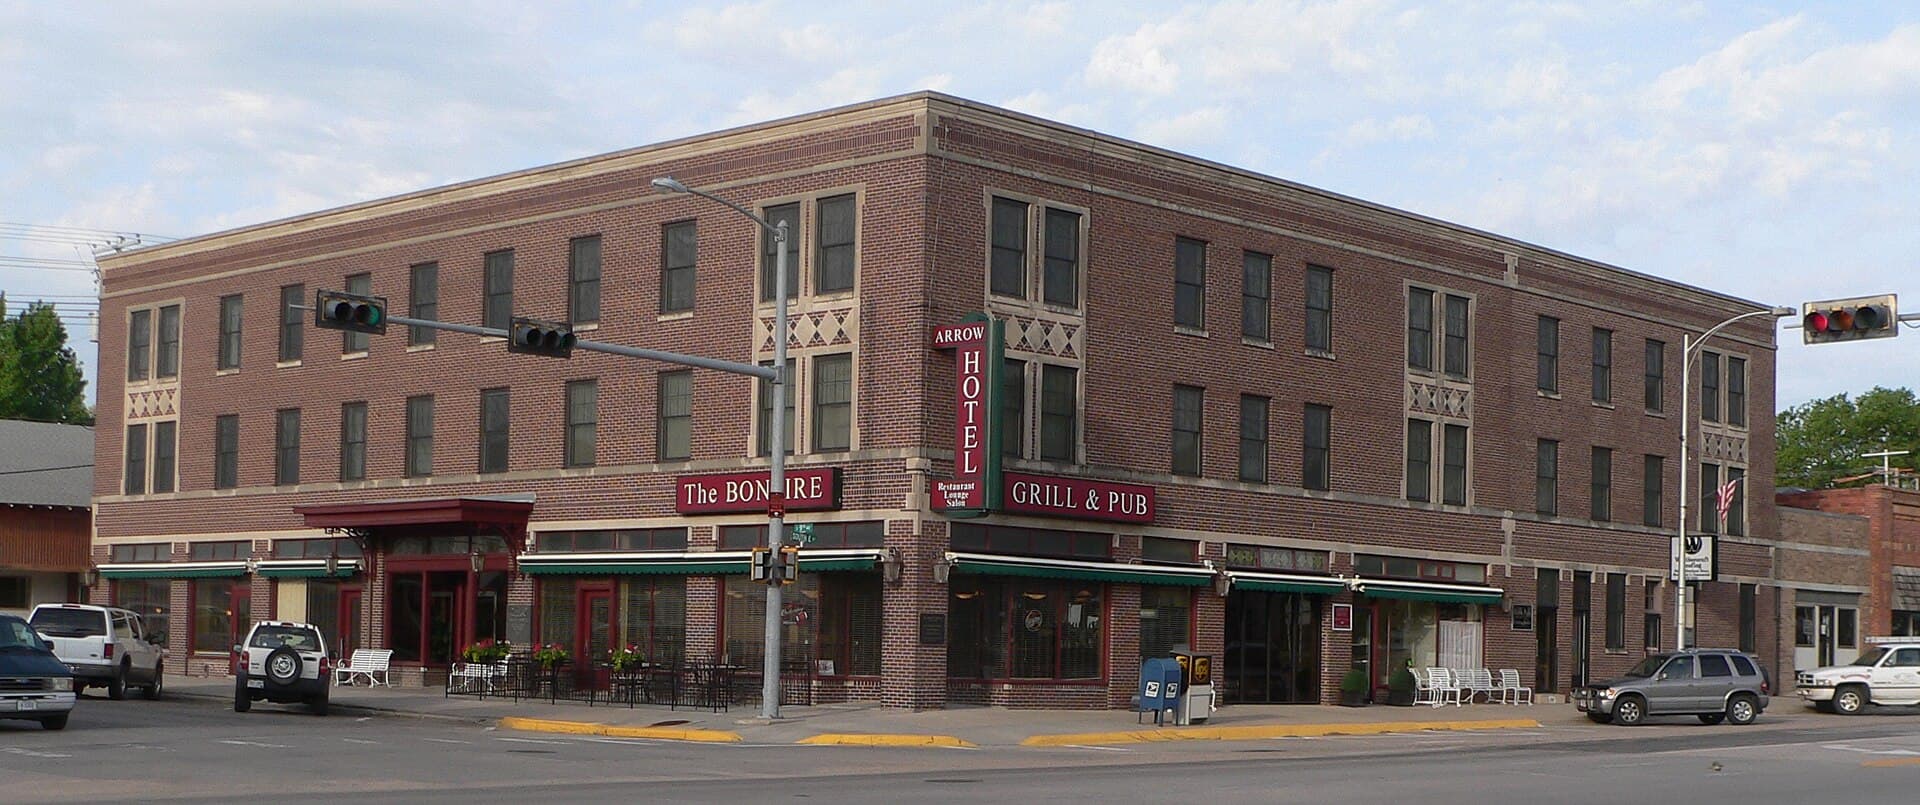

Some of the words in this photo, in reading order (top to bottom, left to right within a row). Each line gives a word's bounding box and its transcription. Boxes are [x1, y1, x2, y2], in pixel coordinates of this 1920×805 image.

[935, 326, 985, 344] ARROW
[962, 350, 981, 473] HOTEL
[683, 482, 718, 505] The
[725, 476, 823, 503] BONIRE
[937, 482, 975, 491] Restaurant
[943, 491, 969, 500] Lounge
[946, 498, 966, 507] Salon
[1012, 481, 1078, 509] GRILL
[1085, 489, 1100, 511] &
[1107, 491, 1147, 515] PUB
